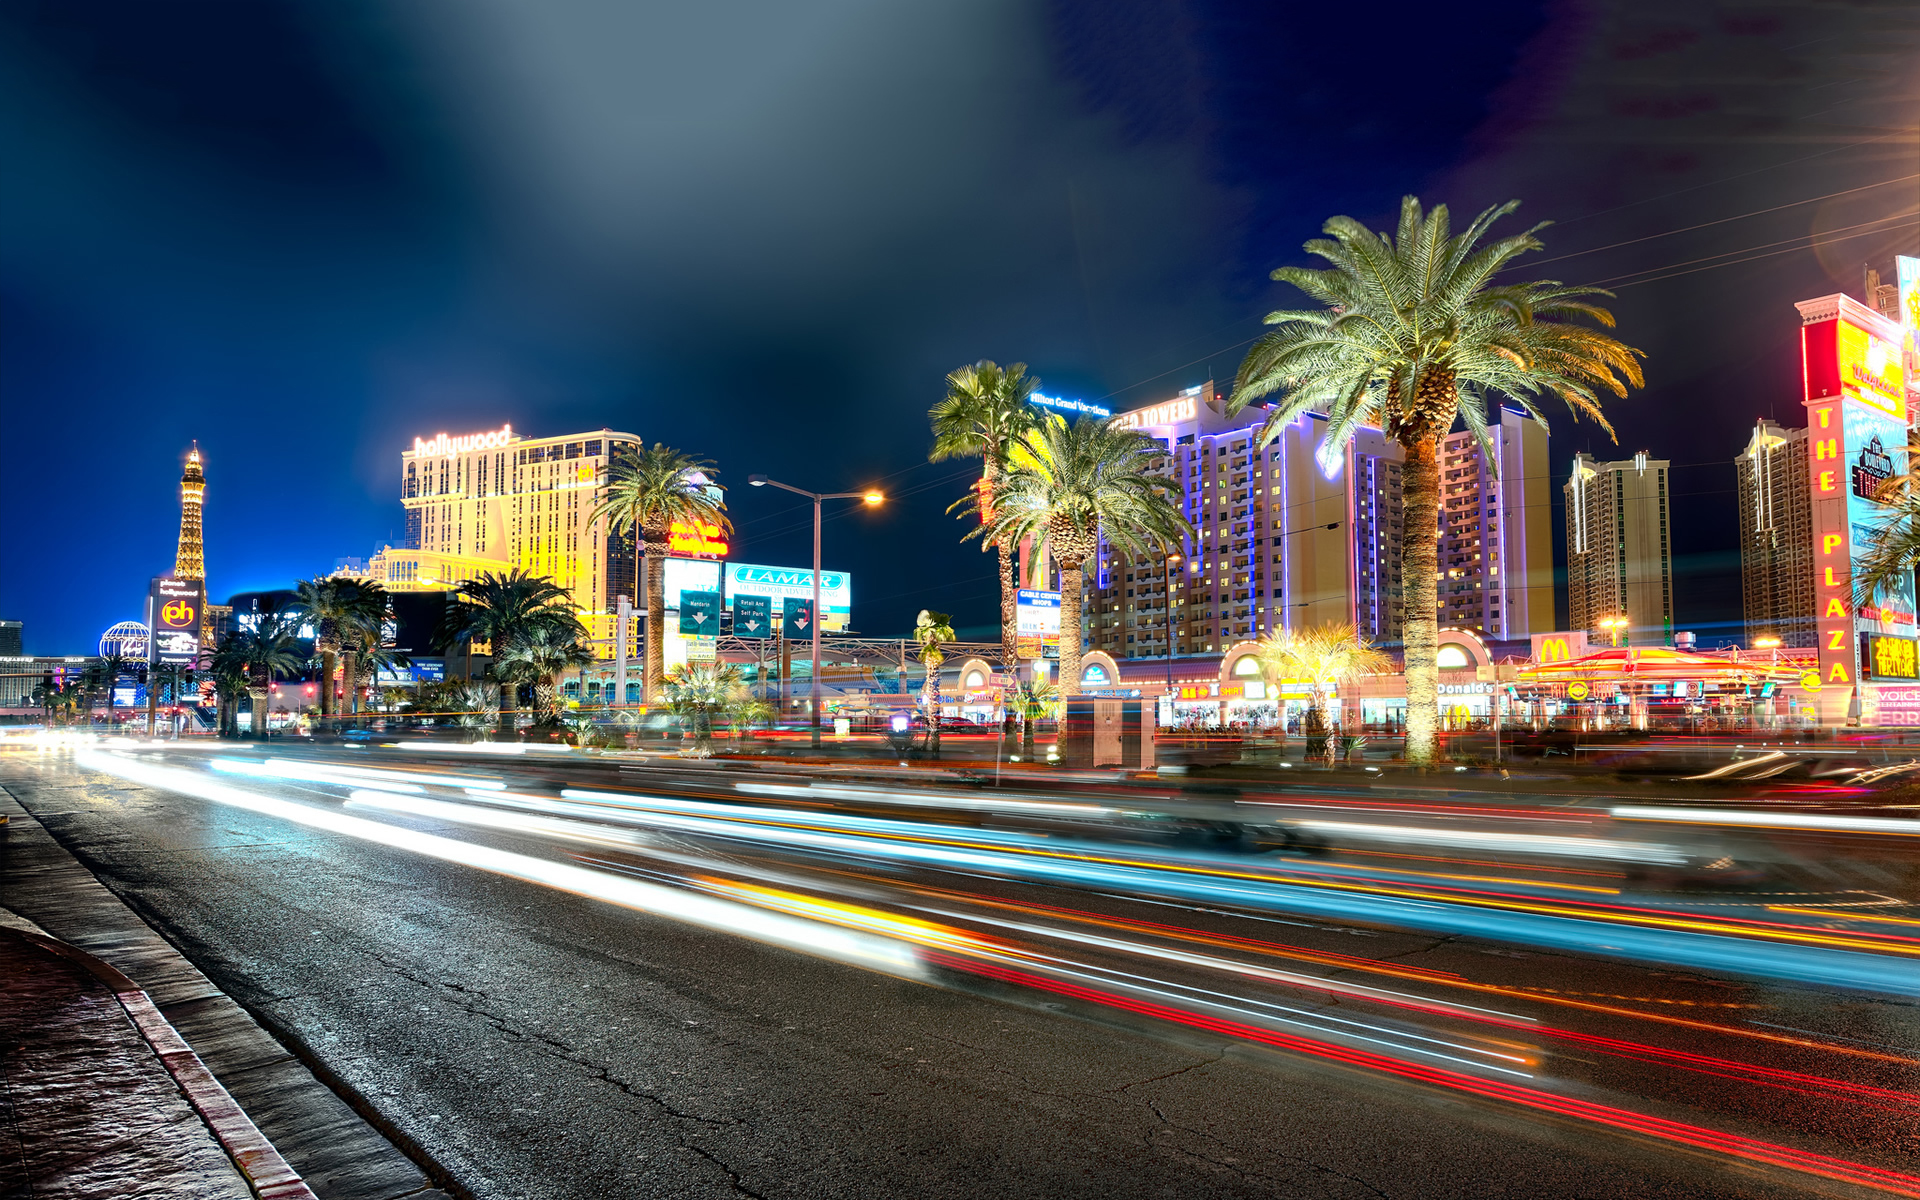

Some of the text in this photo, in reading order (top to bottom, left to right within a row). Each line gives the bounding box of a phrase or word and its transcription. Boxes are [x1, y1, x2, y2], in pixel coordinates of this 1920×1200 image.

[1852, 362, 1901, 399] Walgreens
[1030, 393, 1055, 406] Hilton
[1055, 397, 1077, 410] Grand
[1142, 398, 1196, 428] TOWERS
[415, 424, 511, 460] hollywood
[1816, 407, 1838, 492] THE
[160, 579, 186, 587] planet
[744, 569, 832, 587] LAMAR
[160, 588, 198, 597] hollywood
[739, 583, 838, 598] OUTDOOR ADVERSING
[165, 600, 194, 624] ph
[1823, 534, 1850, 682] PLAZA
[1220, 686, 1244, 696] SHIRT
[1437, 683, 1494, 695] Donald's
[1878, 691, 1920, 701] VOICE
